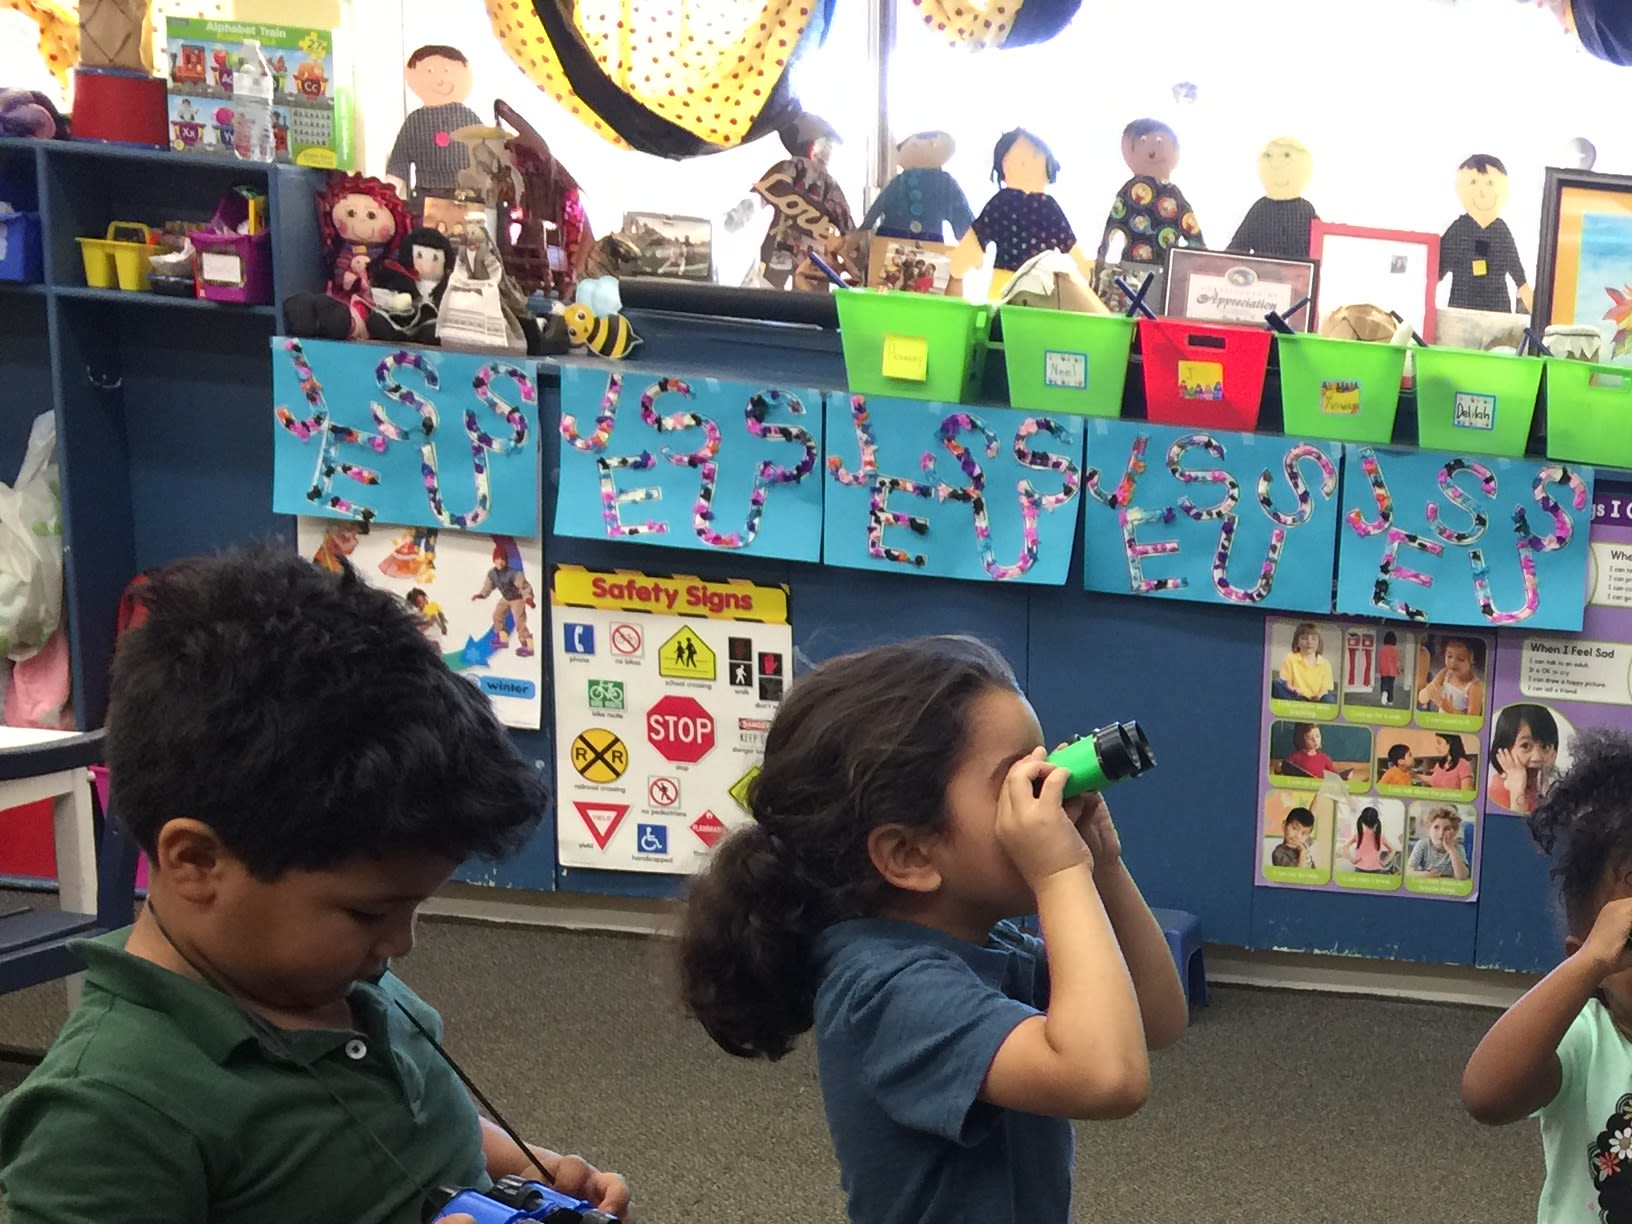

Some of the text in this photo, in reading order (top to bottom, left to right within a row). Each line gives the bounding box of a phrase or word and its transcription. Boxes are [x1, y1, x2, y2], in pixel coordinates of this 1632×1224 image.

[206, 21, 256, 36] Alphabet
[260, 26, 287, 39] Train
[1196, 287, 1278, 310] Appreciation
[1456, 402, 1490, 420] Delilah
[1610, 500, 1620, 518] I
[592, 577, 754, 613] Safety Signs
[1530, 642, 1560, 655] When
[1571, 646, 1593, 656] Feel
[1595, 648, 1615, 658] Sad
[486, 680, 529, 695] winter
[665, 680, 712, 690] school crossing
[650, 715, 712, 745] STOP
[575, 747, 624, 764] R R
[632, 854, 673, 864] handicapped
